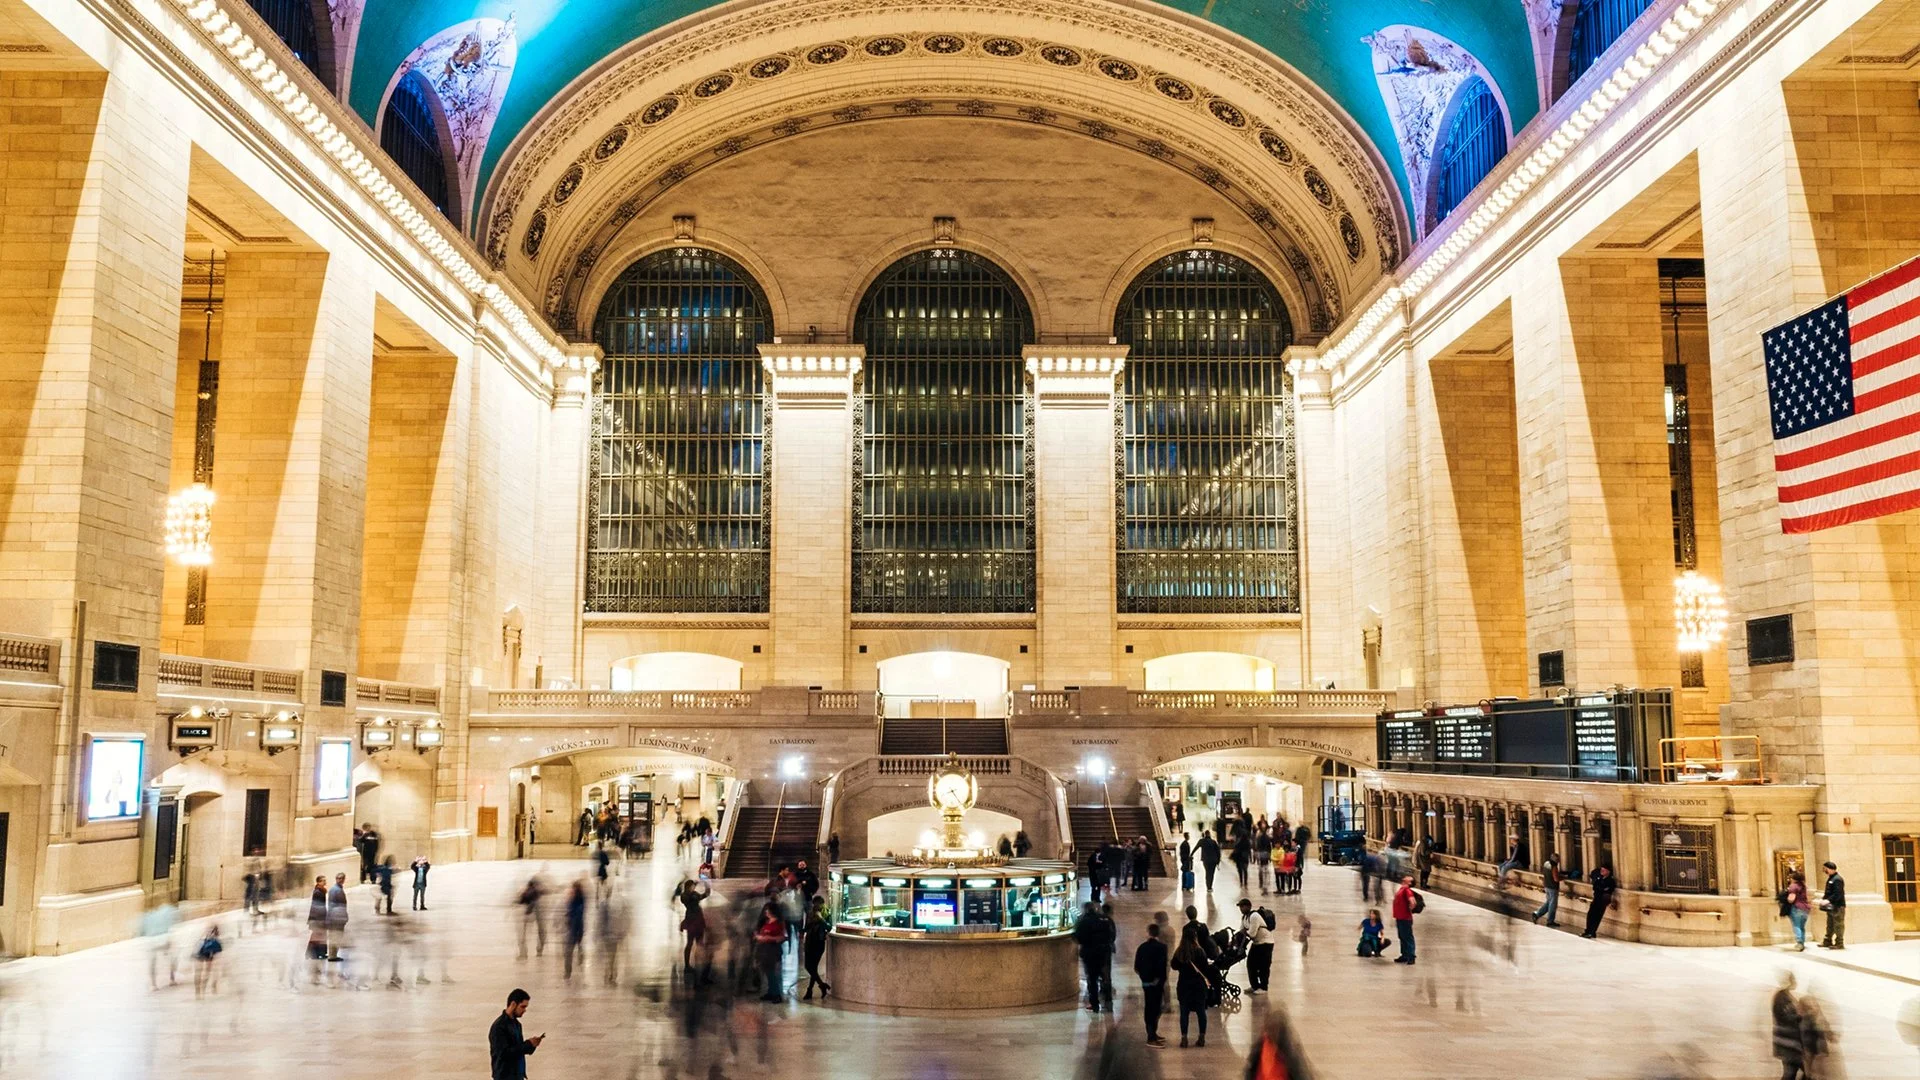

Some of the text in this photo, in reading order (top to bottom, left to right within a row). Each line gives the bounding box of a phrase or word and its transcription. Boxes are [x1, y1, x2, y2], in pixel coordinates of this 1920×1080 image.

[545, 742, 578, 753] TRACKS
[638, 738, 708, 755] LEXINGTON AVE
[1180, 737, 1249, 755] LEXINGTON AVE
[1278, 738, 1353, 756] TICKET MACHINES
